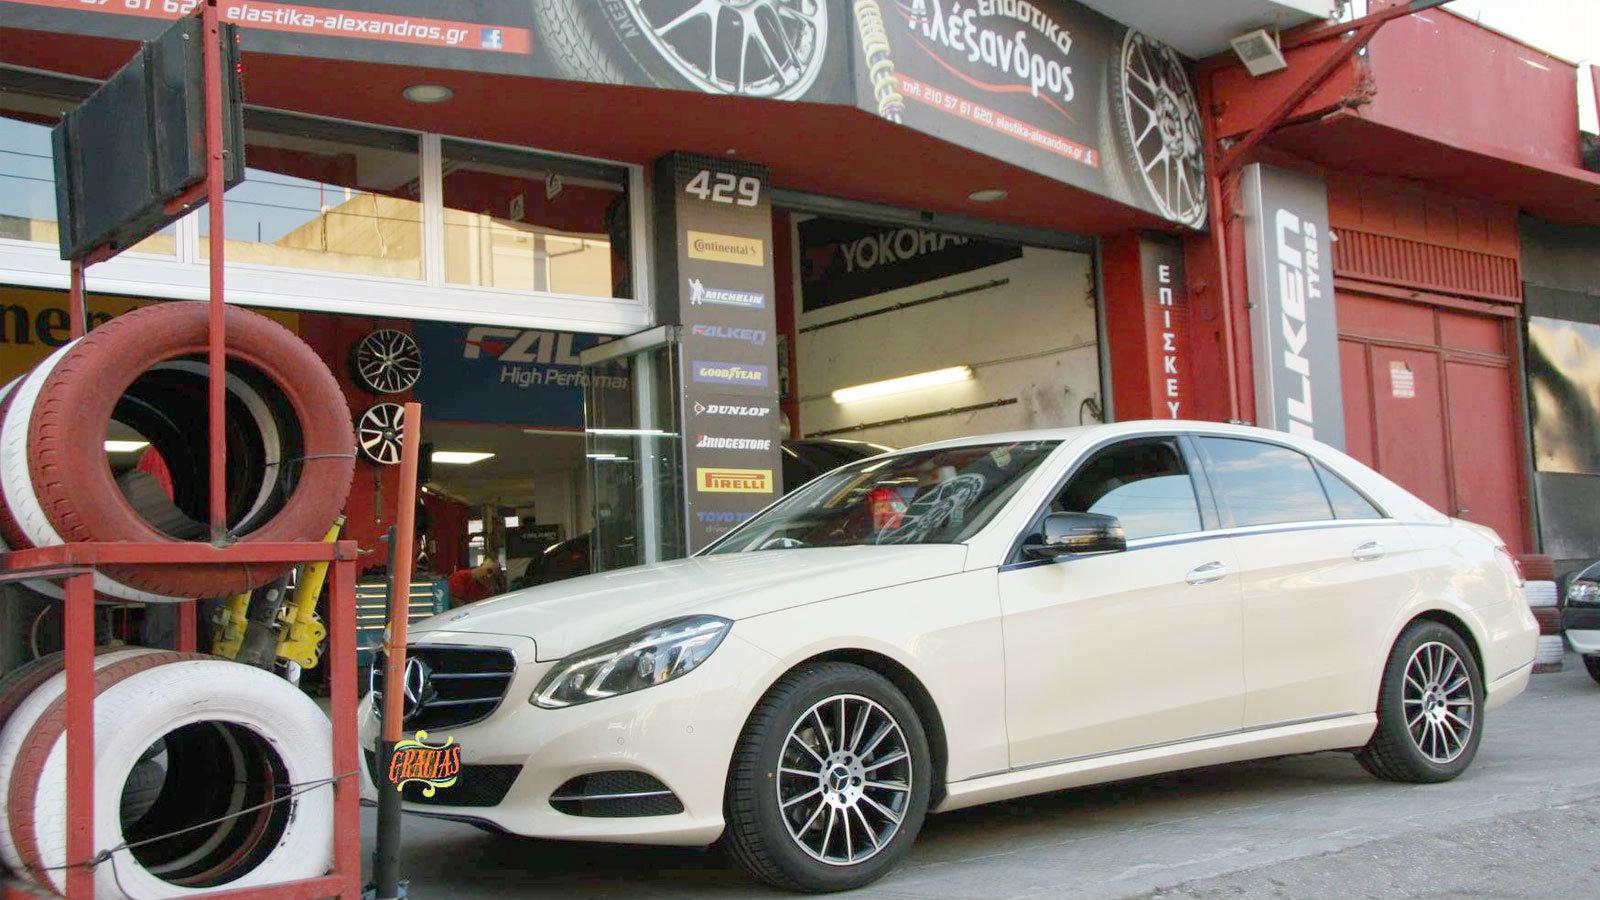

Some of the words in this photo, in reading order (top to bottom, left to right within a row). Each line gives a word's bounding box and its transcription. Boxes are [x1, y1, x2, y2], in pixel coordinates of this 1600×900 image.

[227, 5, 468, 44] elastika-alexandros.gr
[923, 86, 942, 104] 210
[943, 94, 958, 109] 57
[960, 101, 971, 115] 61
[996, 117, 1082, 160] elastika-alexandros.gr
[685, 169, 761, 207] 429
[693, 238, 748, 256] Continental
[1303, 221, 1322, 298] TYRES
[704, 290, 763, 305] MICHELIN
[691, 324, 768, 343] FALKEN
[1275, 208, 1315, 440] LKEN
[460, 326, 602, 366] FAL
[1158, 264, 1181, 420] ΕΠΙΣΚΕΥ
[501, 367, 543, 388] High
[700, 366, 762, 381] GOODYEAR
[706, 404, 770, 417] DUNLOP
[696, 434, 771, 450] BRIDGESTONE
[704, 472, 766, 489] PIRELLI
[696, 511, 735, 522] TOYO
